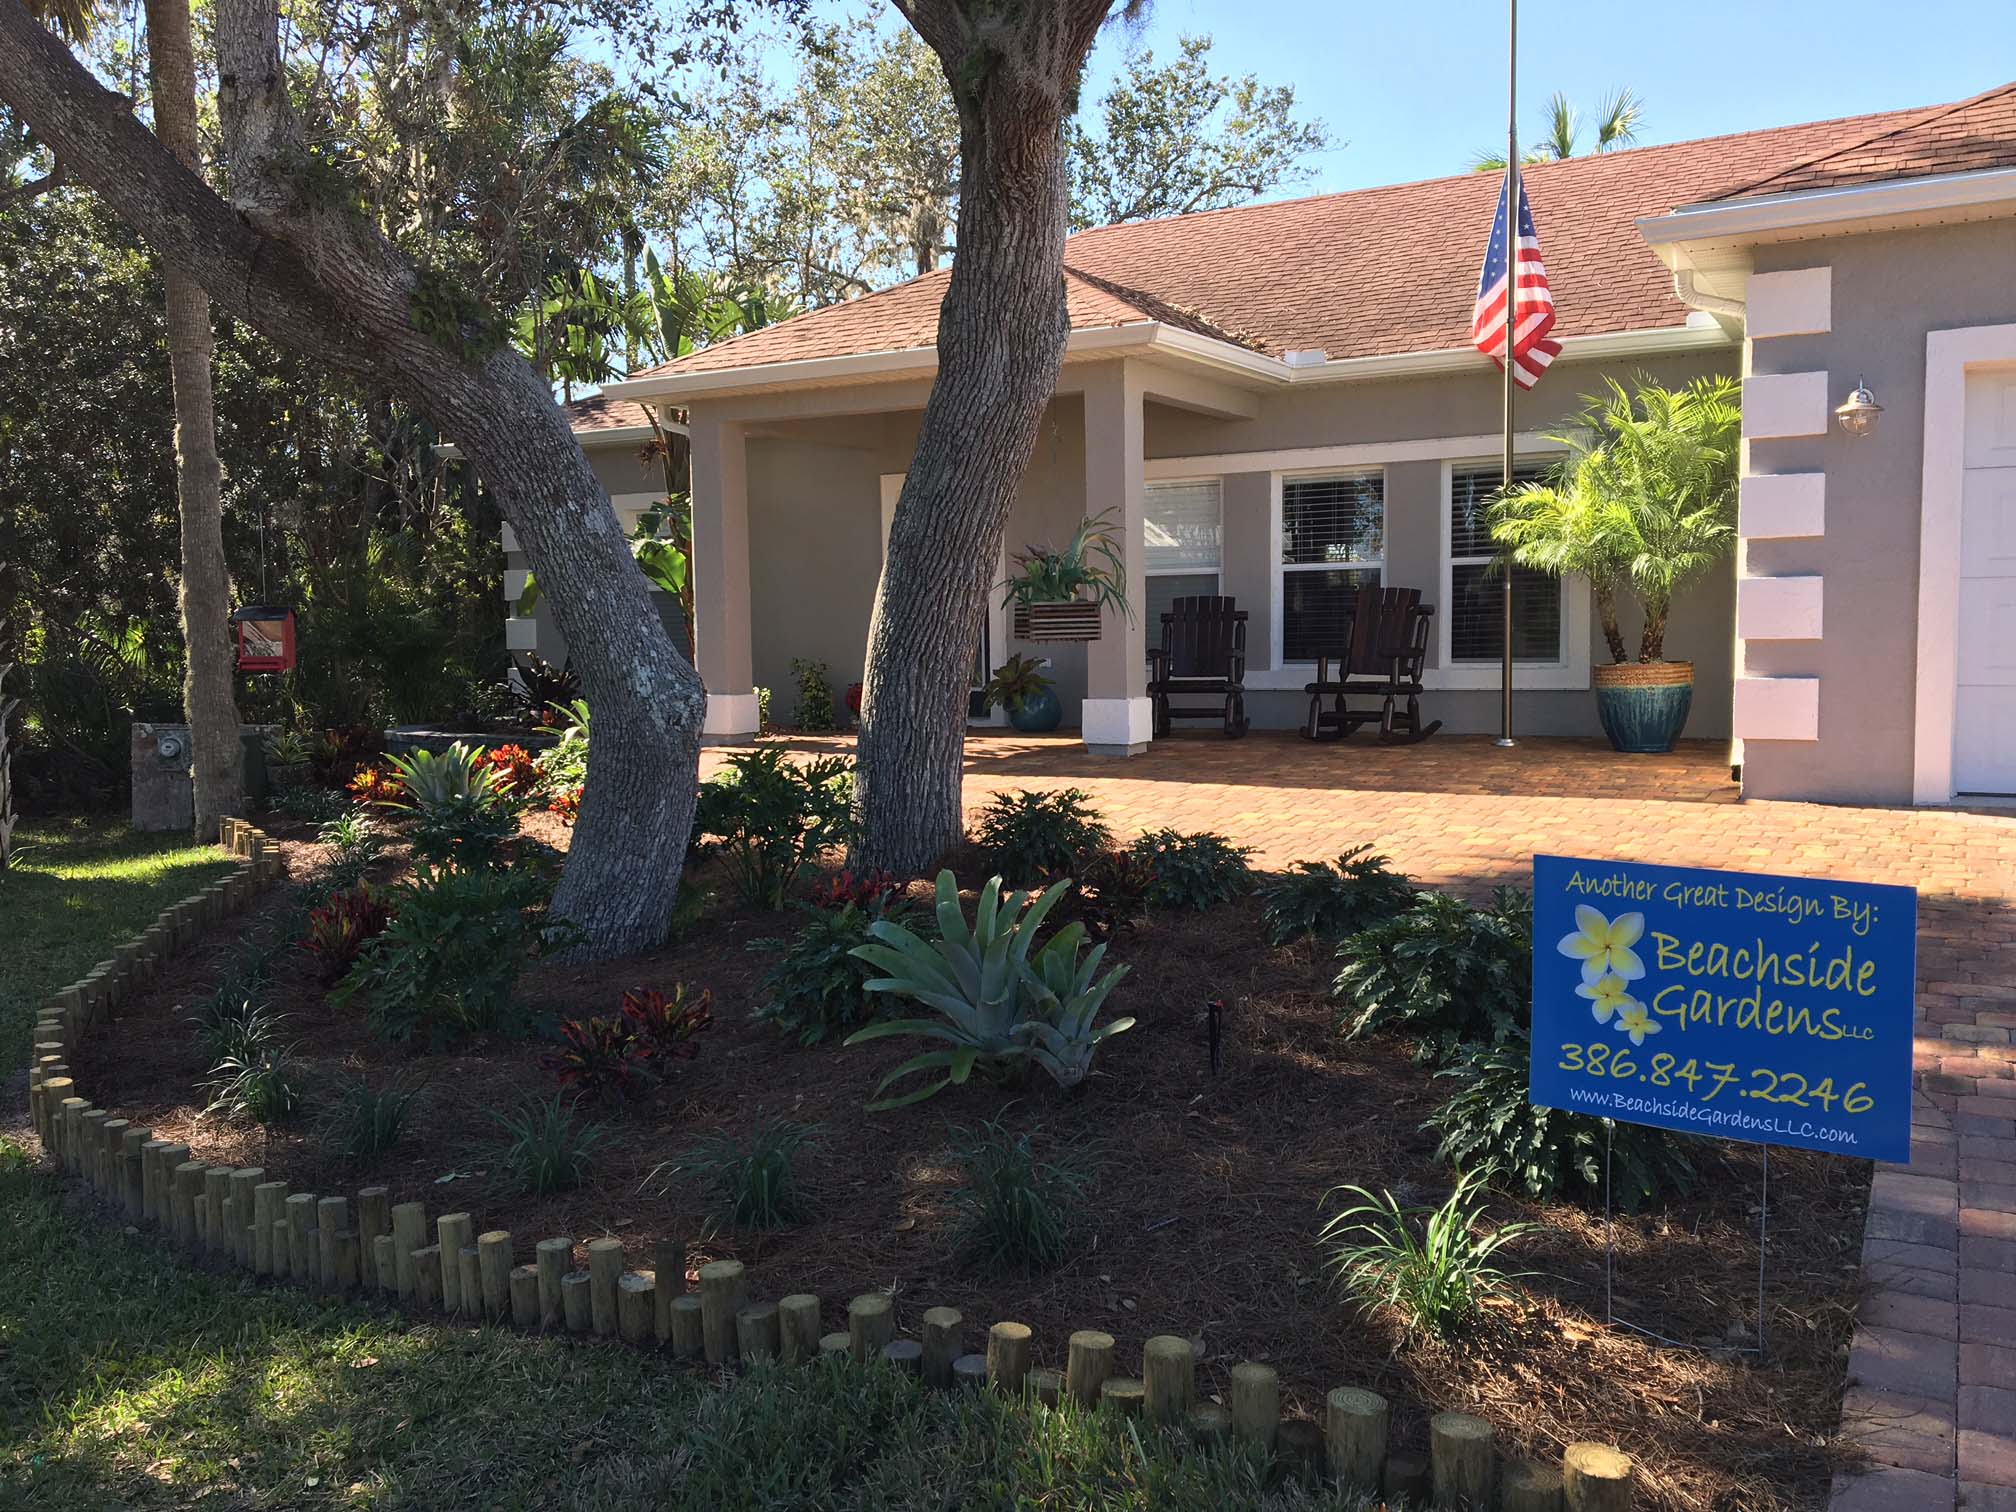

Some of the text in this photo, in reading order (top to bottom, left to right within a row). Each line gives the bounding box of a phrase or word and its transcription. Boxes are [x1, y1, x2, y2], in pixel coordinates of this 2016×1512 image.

[1565, 870, 1880, 935] Another Great Design By:
[1651, 931, 1876, 996] Beachside
[1558, 1042, 1874, 1113] 386.847.2246
[1570, 1088, 1858, 1144] www.BeachsideGardensLLC.com
